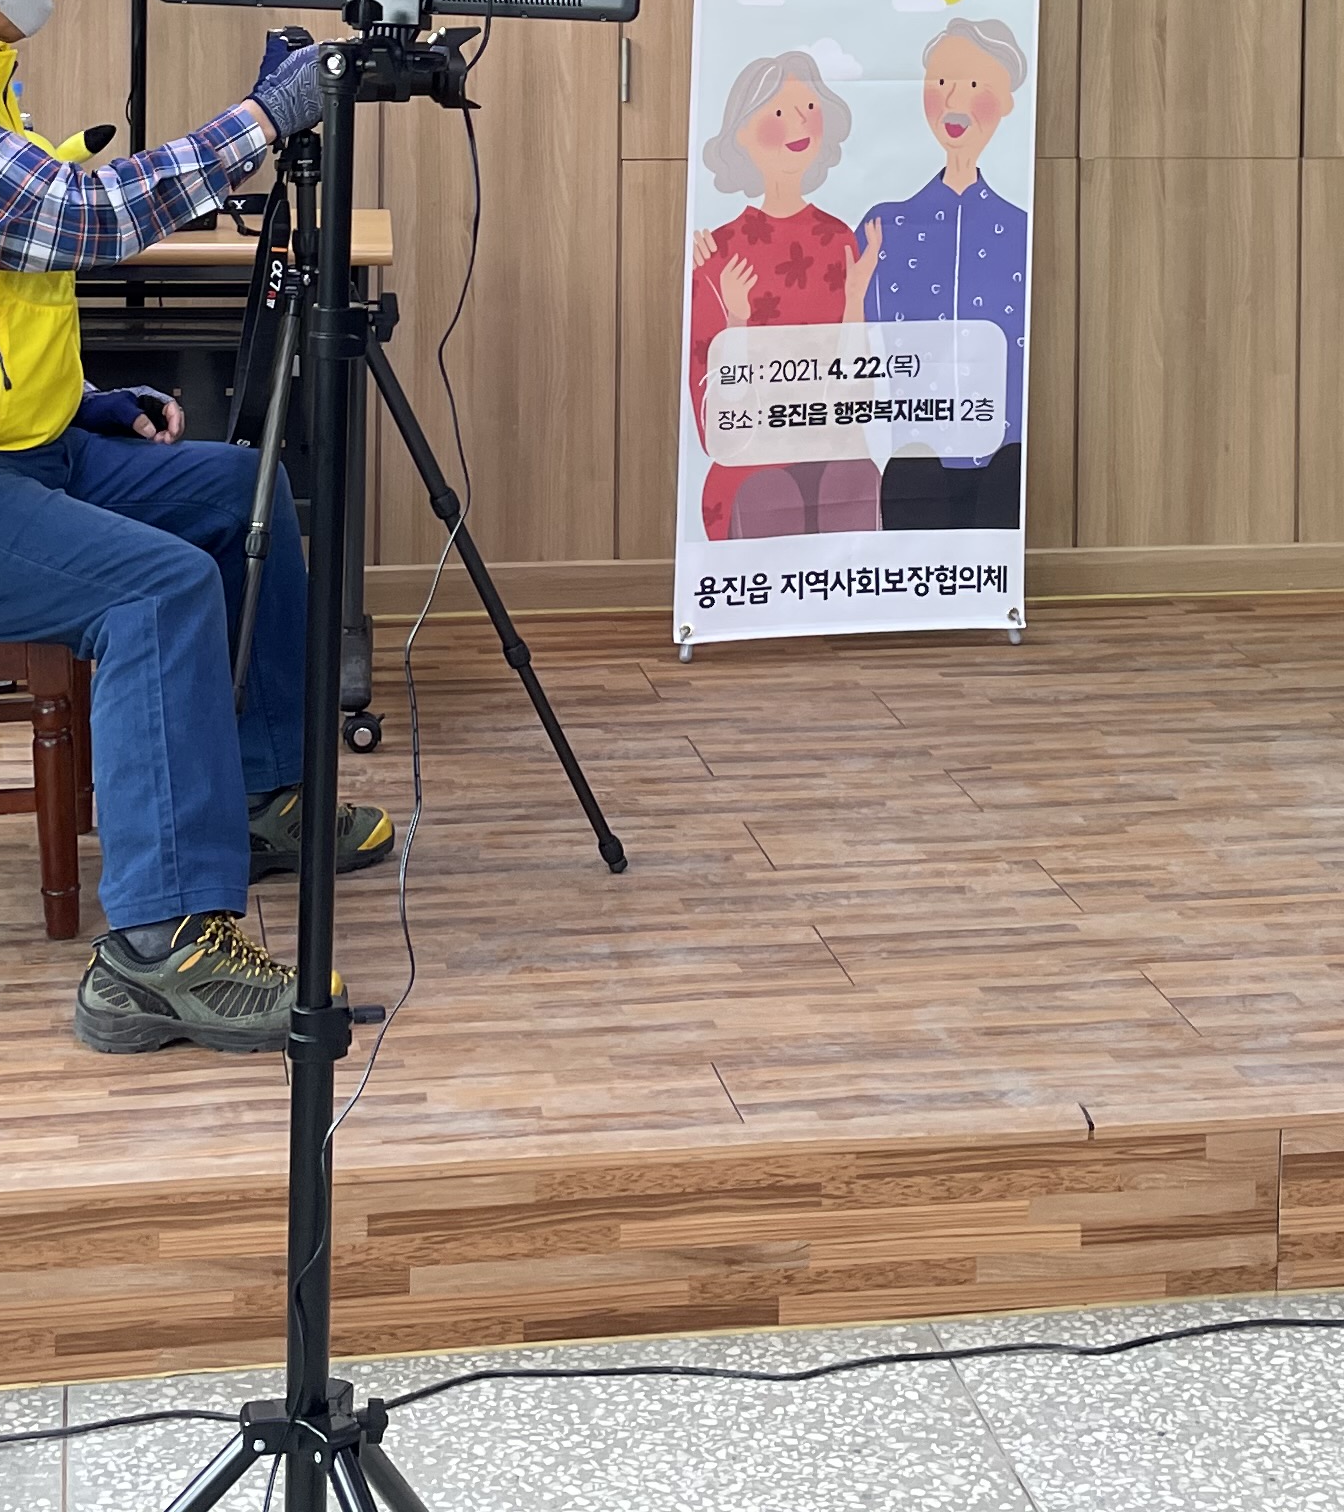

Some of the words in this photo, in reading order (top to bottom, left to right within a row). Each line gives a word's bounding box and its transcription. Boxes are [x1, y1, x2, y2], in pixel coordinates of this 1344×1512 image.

[719, 363, 754, 385] 일자
[769, 358, 823, 383] 2021.
[718, 409, 754, 431] 장소
[767, 402, 829, 428] 용진읍
[833, 398, 955, 425] 행정복지센터
[960, 397, 995, 422] 2층
[694, 572, 773, 609] 용진읍
[780, 563, 1009, 601] 지역사회보장협의체
